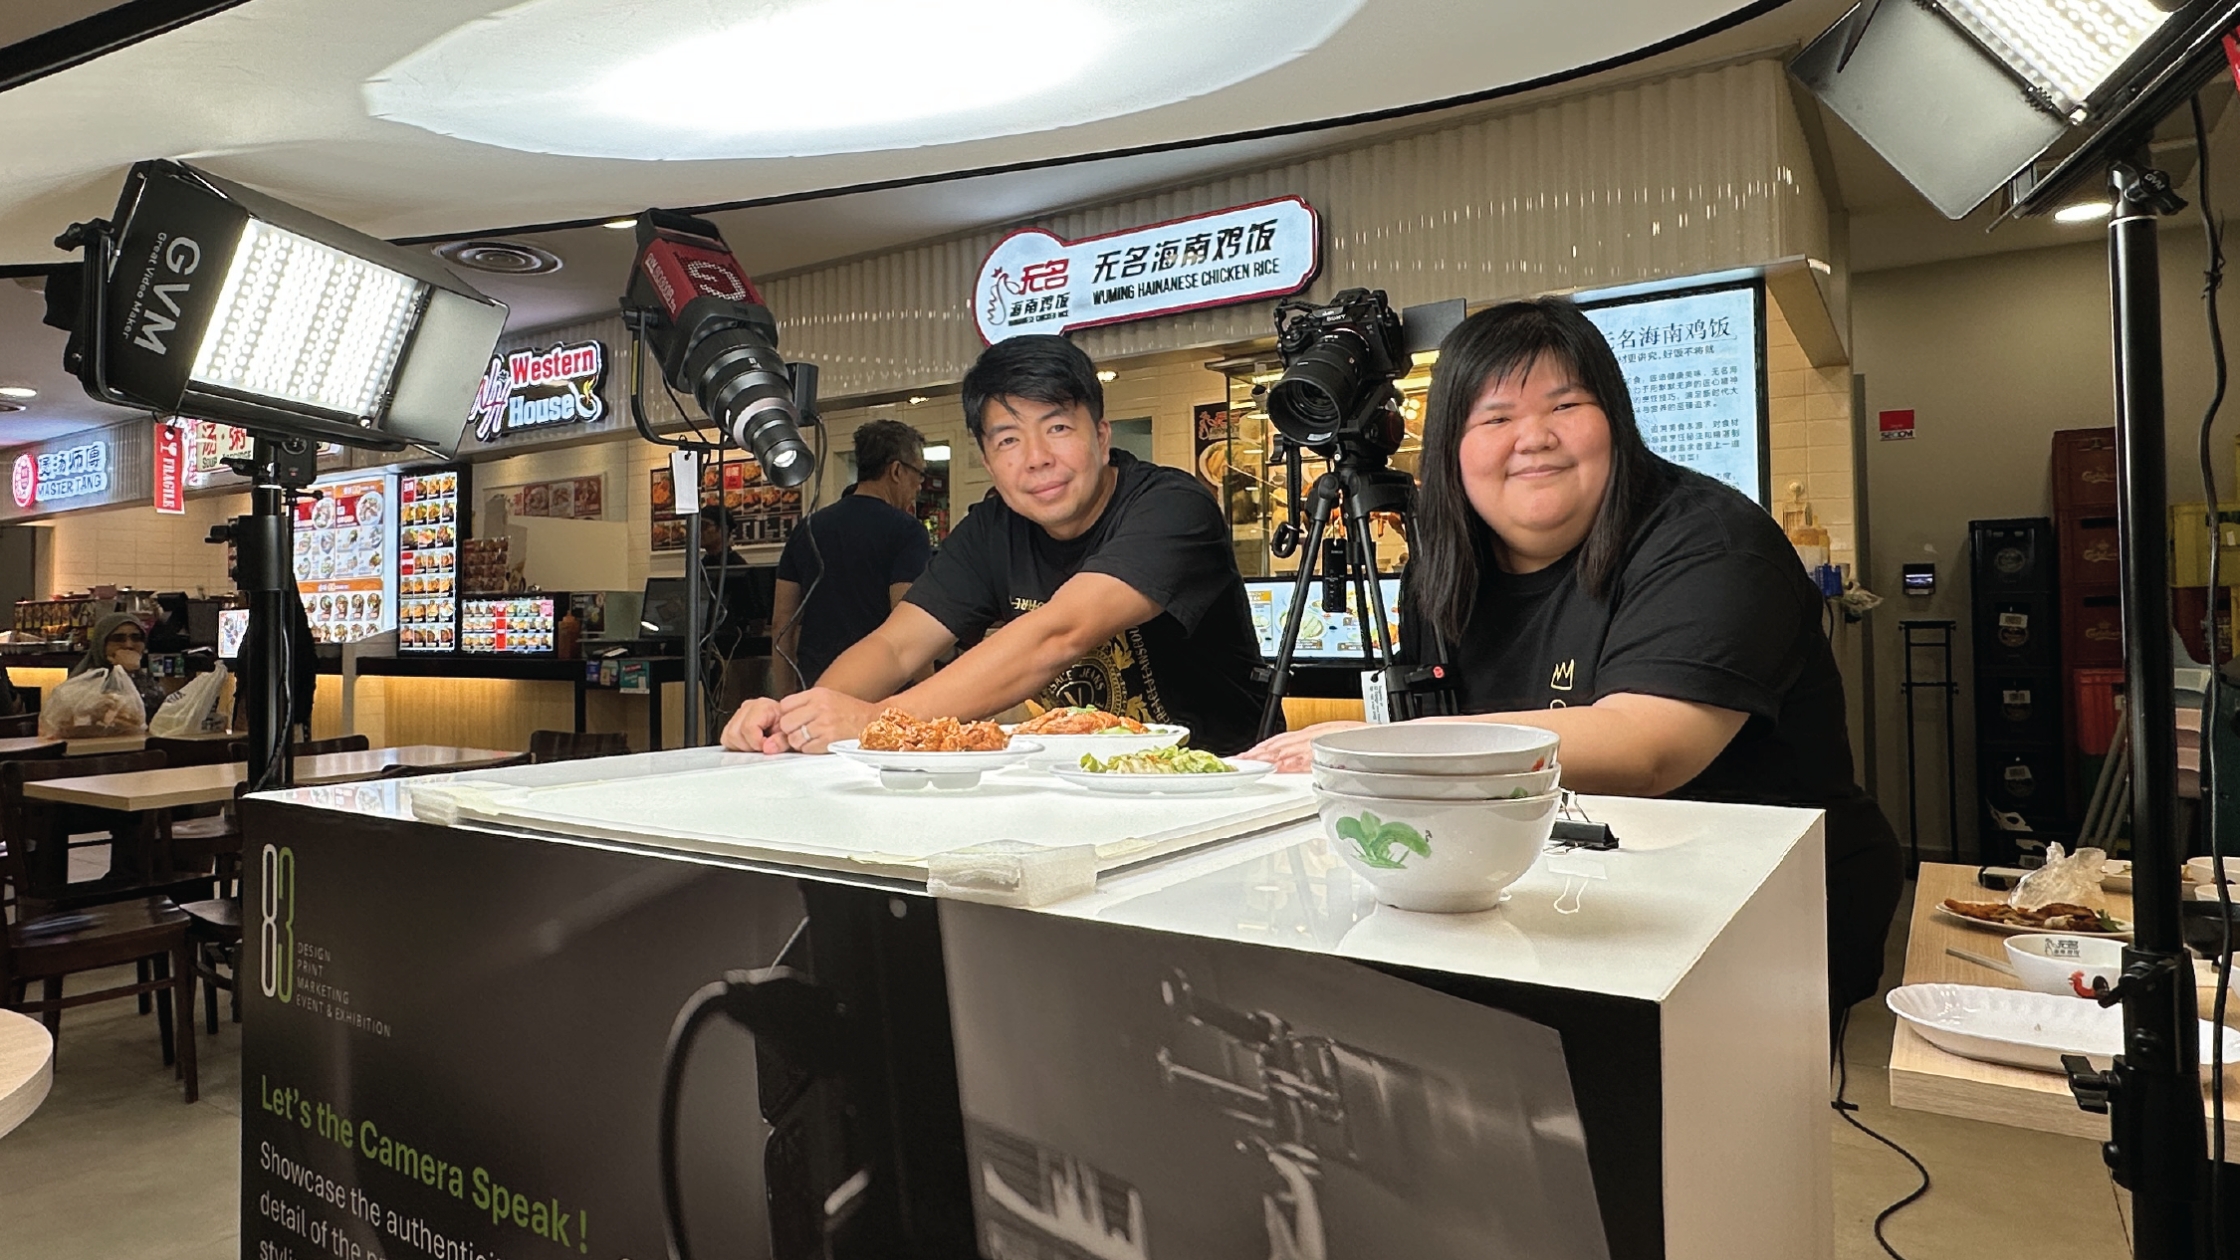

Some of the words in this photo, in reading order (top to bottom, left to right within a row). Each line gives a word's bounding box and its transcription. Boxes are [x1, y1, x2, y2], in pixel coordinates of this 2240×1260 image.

[148, 232, 167, 265] Great
[1091, 218, 1278, 284] 无名海南鸡饭
[136, 267, 155, 299] Video
[1019, 259, 1069, 295] 无名
[1092, 285, 1134, 305] WUMING
[1137, 273, 1199, 298] HAINANESE
[1201, 264, 1250, 286] CHICKEN
[1253, 257, 1280, 278] RICE
[133, 236, 201, 355] GVM
[1009, 292, 1070, 317] 海南鸡饭
[122, 300, 143, 340] Maker
[511, 349, 594, 385] Western
[508, 394, 575, 427] House
[202, 457, 217, 469] SOUP
[38, 481, 74, 497] MASTER
[76, 474, 102, 491] TANG
[162, 457, 176, 509] FRAGILE
[261, 843, 295, 1004] 83
[296, 959, 323, 977] PRINT
[297, 942, 331, 962] DESIGN
[296, 976, 350, 1005] MARKETING
[296, 993, 324, 1013] EVENT
[326, 1004, 332, 1018] &
[335, 1007, 391, 1037] EXHIBITION
[261, 1074, 311, 1129] Let's
[316, 1102, 353, 1149] the
[360, 1120, 464, 1199] Camera
[260, 1141, 346, 1209] Showcase
[350, 1188, 381, 1227] the
[260, 1190, 307, 1238] detail
[310, 1220, 327, 1248] of
[331, 1227, 361, 1260] the
